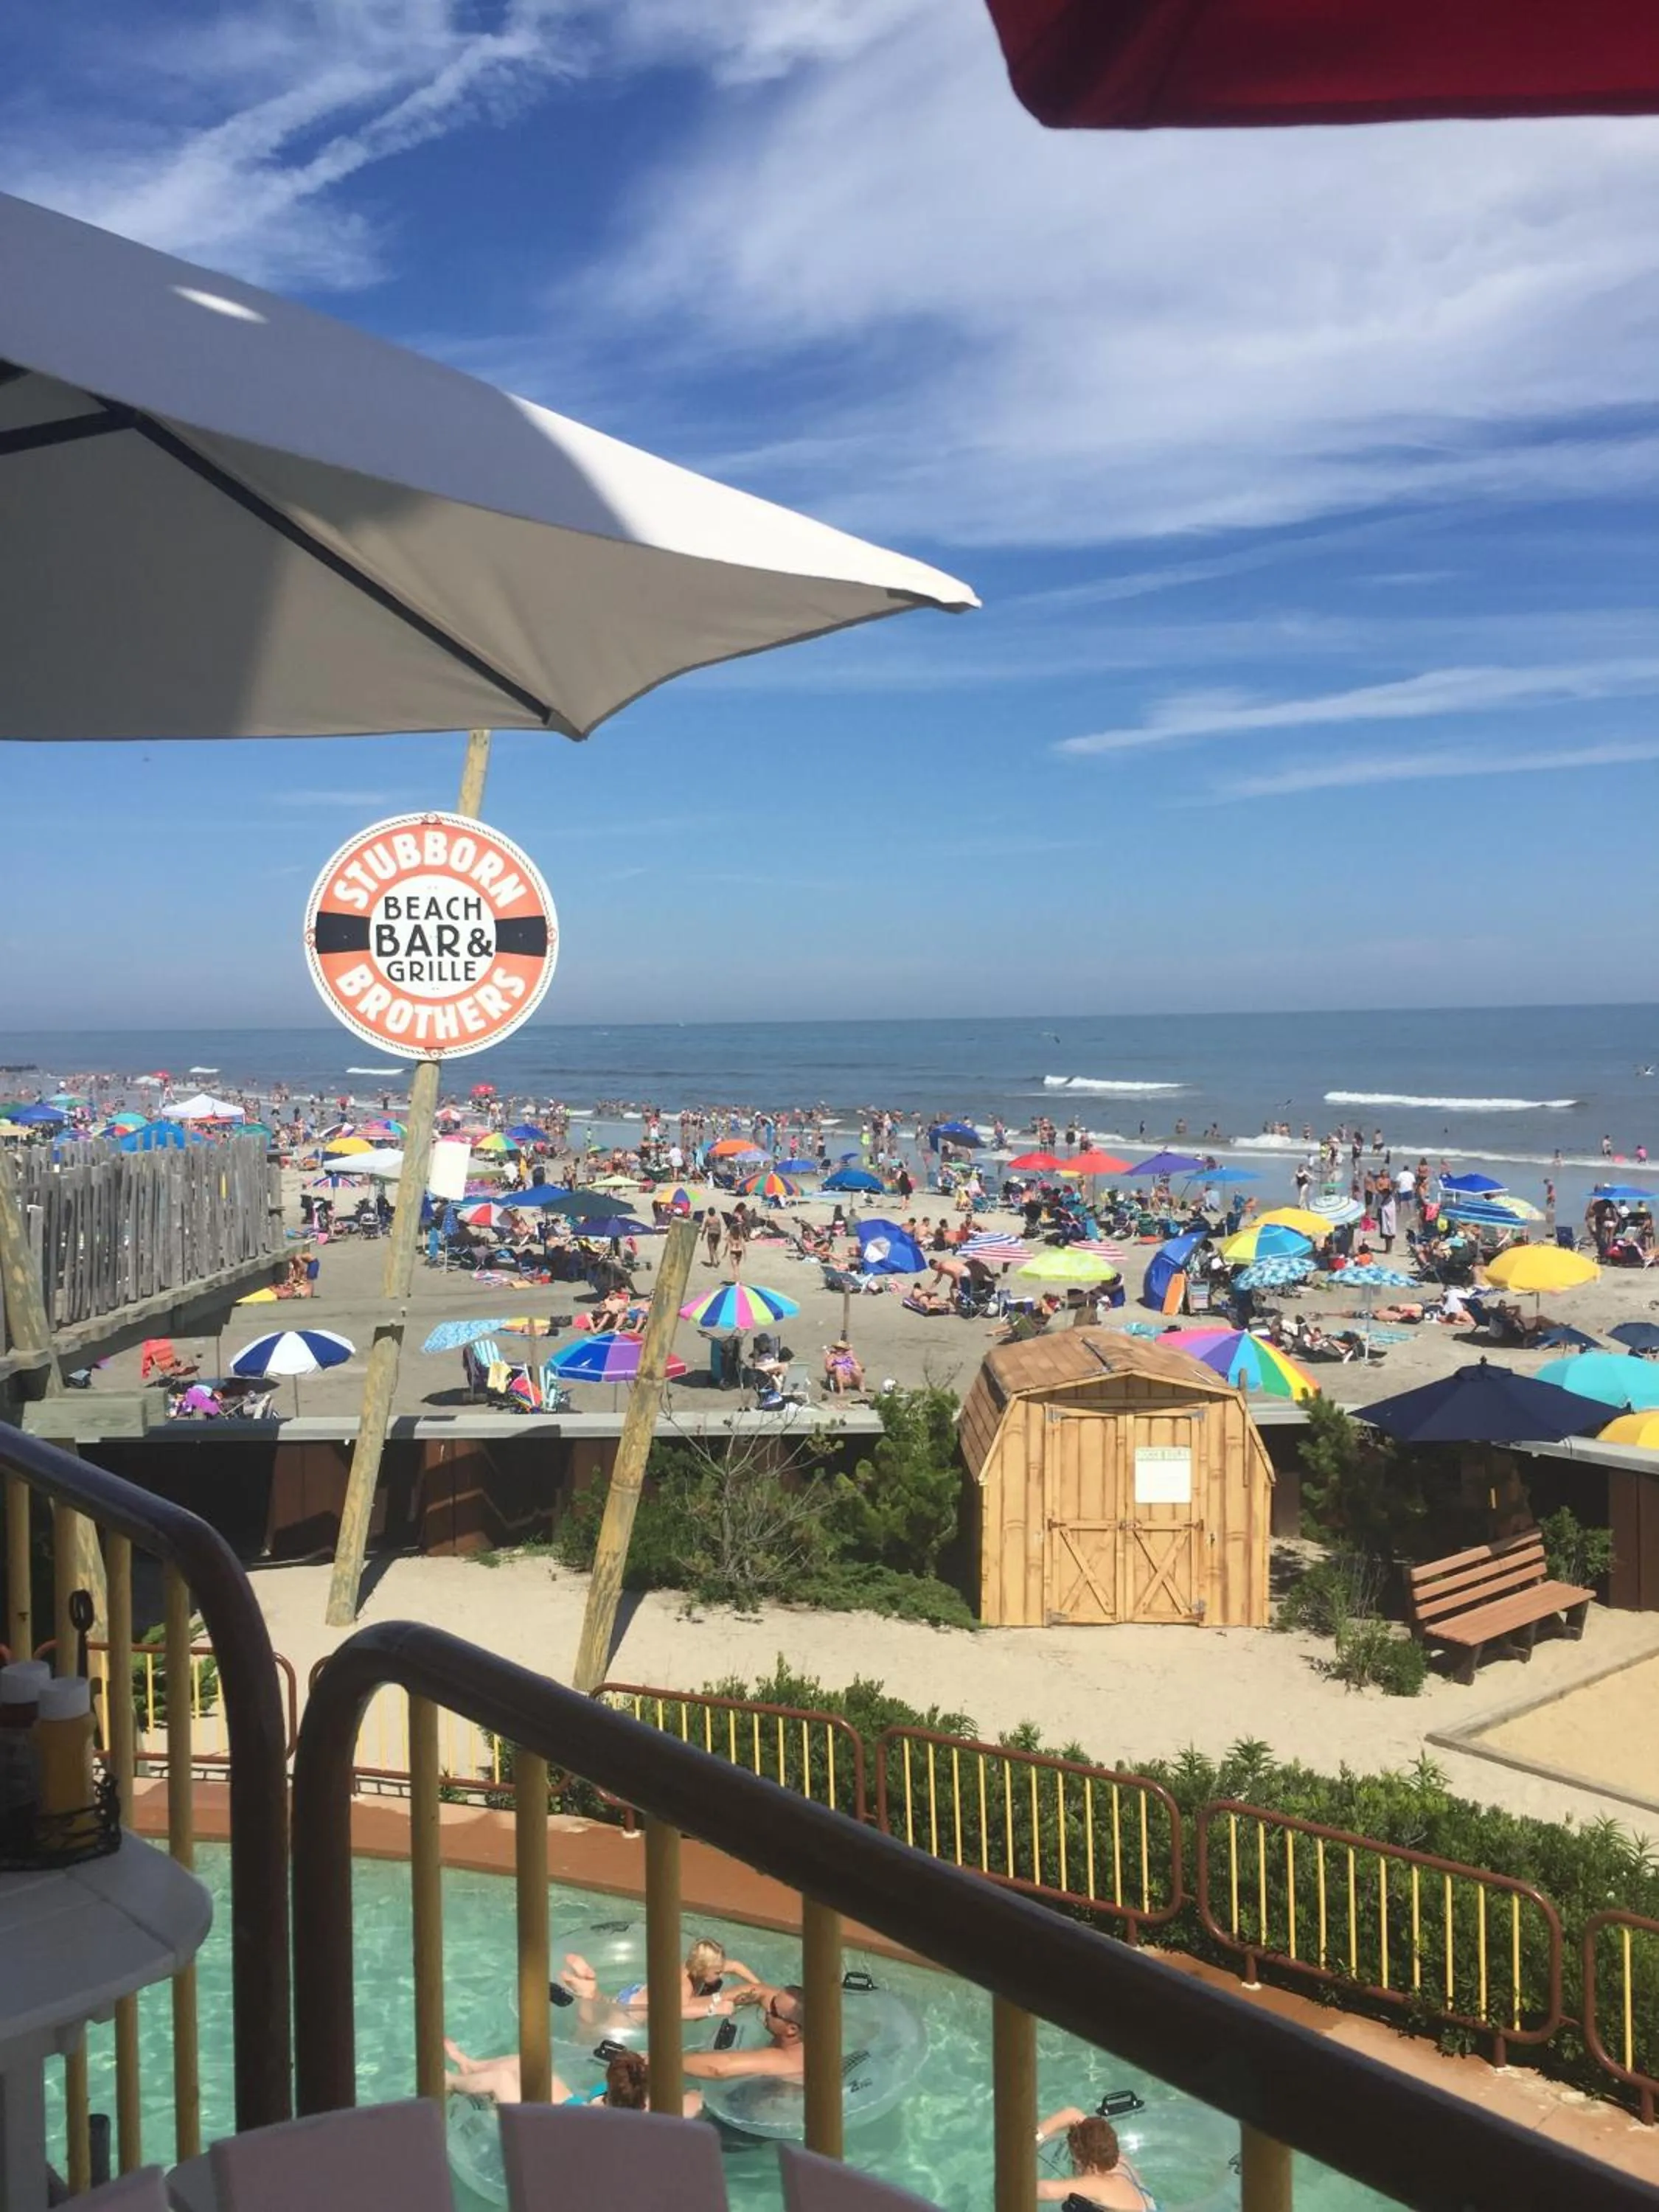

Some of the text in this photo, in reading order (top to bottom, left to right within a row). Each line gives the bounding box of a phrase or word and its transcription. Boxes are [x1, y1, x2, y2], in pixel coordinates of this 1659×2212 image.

[334, 830, 528, 910] STUBBORN
[383, 896, 482, 921] BEACH
[386, 960, 477, 982] GRILLE
[335, 963, 526, 1040] BROTHERS
